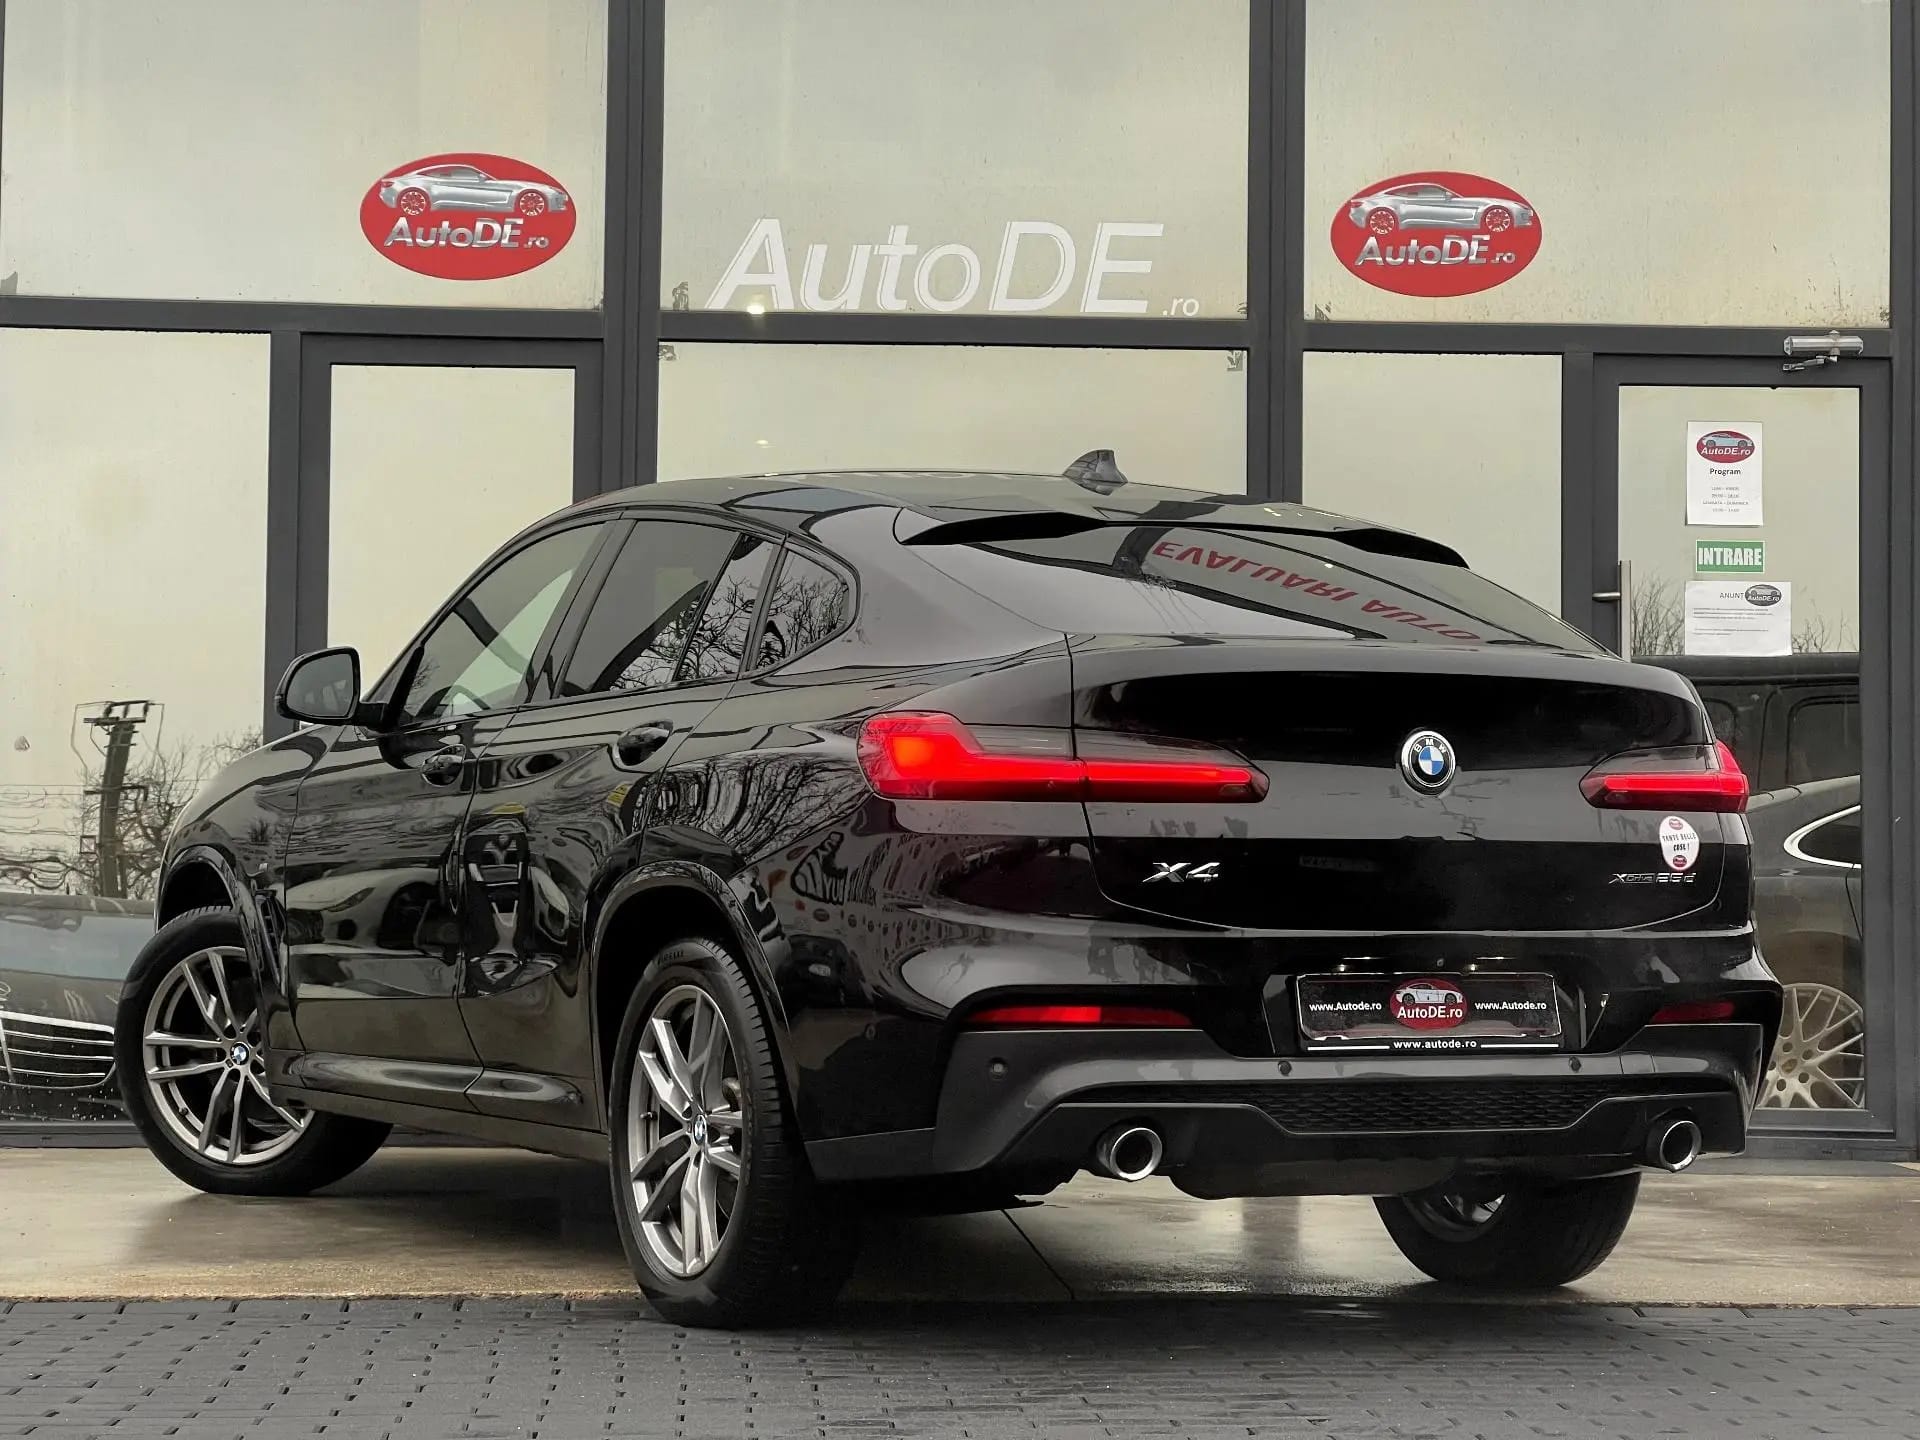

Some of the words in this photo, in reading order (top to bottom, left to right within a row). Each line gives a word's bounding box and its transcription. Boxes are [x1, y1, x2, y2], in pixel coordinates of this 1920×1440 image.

[1709, 467, 1742, 477] Program
[1698, 547, 1763, 566] INTRARE
[1142, 862, 1220, 883] X4
[1309, 1001, 1382, 1011] www.Autode.ro
[1475, 1000, 1547, 1011] www.Autode.ro
[1396, 1005, 1463, 1020] AutoDE.ro
[1393, 1039, 1477, 1049] www.autode.ro
